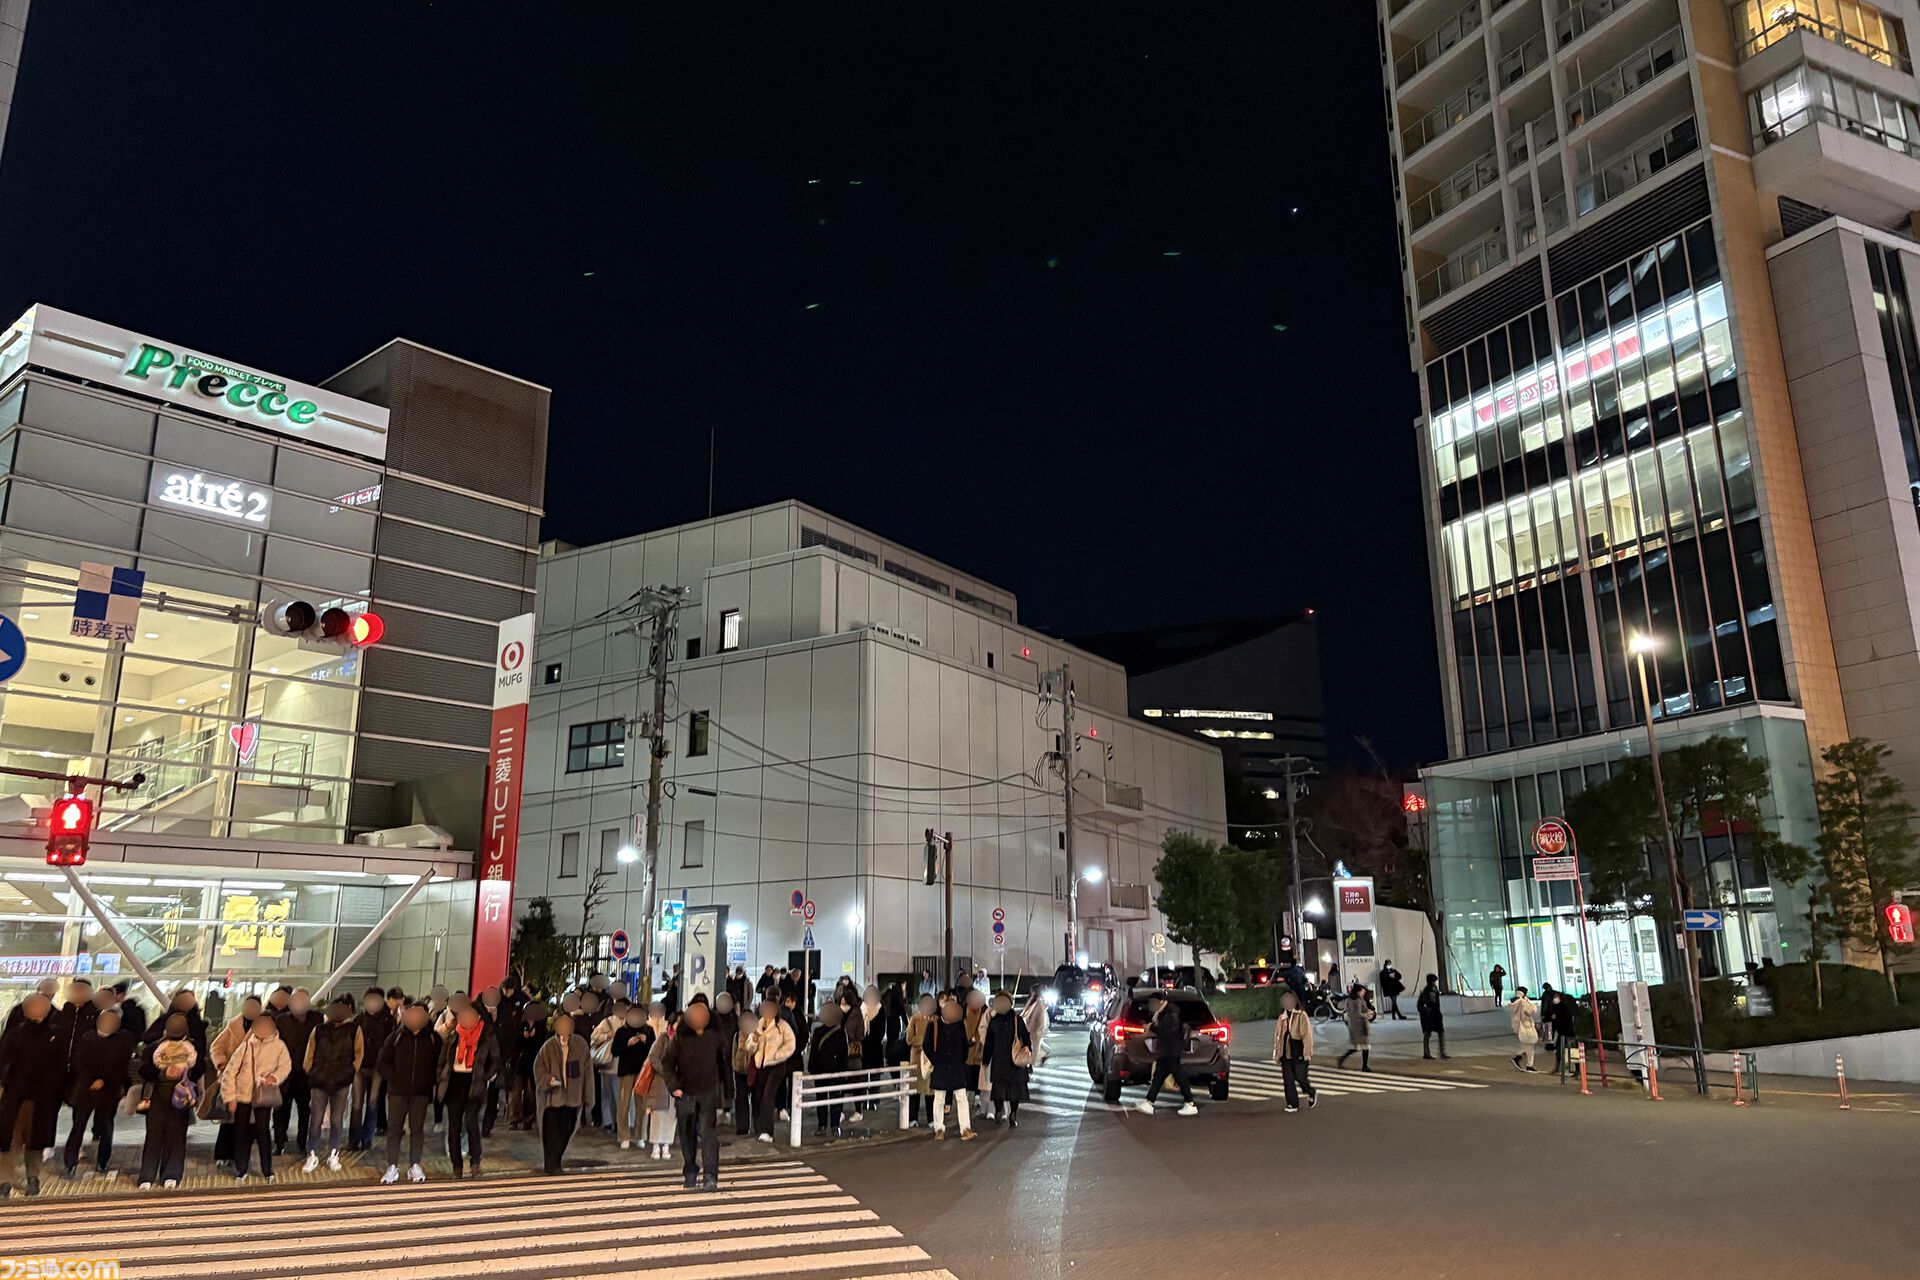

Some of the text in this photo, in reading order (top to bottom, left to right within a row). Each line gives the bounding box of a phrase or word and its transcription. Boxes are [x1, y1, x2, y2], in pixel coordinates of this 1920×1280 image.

[187, 356, 213, 370] FOOD
[215, 365, 251, 381] MARKET
[125, 343, 317, 424] Precce
[73, 620, 134, 641] 時差式
[499, 673, 522, 688] MUFG
[485, 727, 514, 922] 三菱UFJ銀行
[690, 953, 706, 985] P
